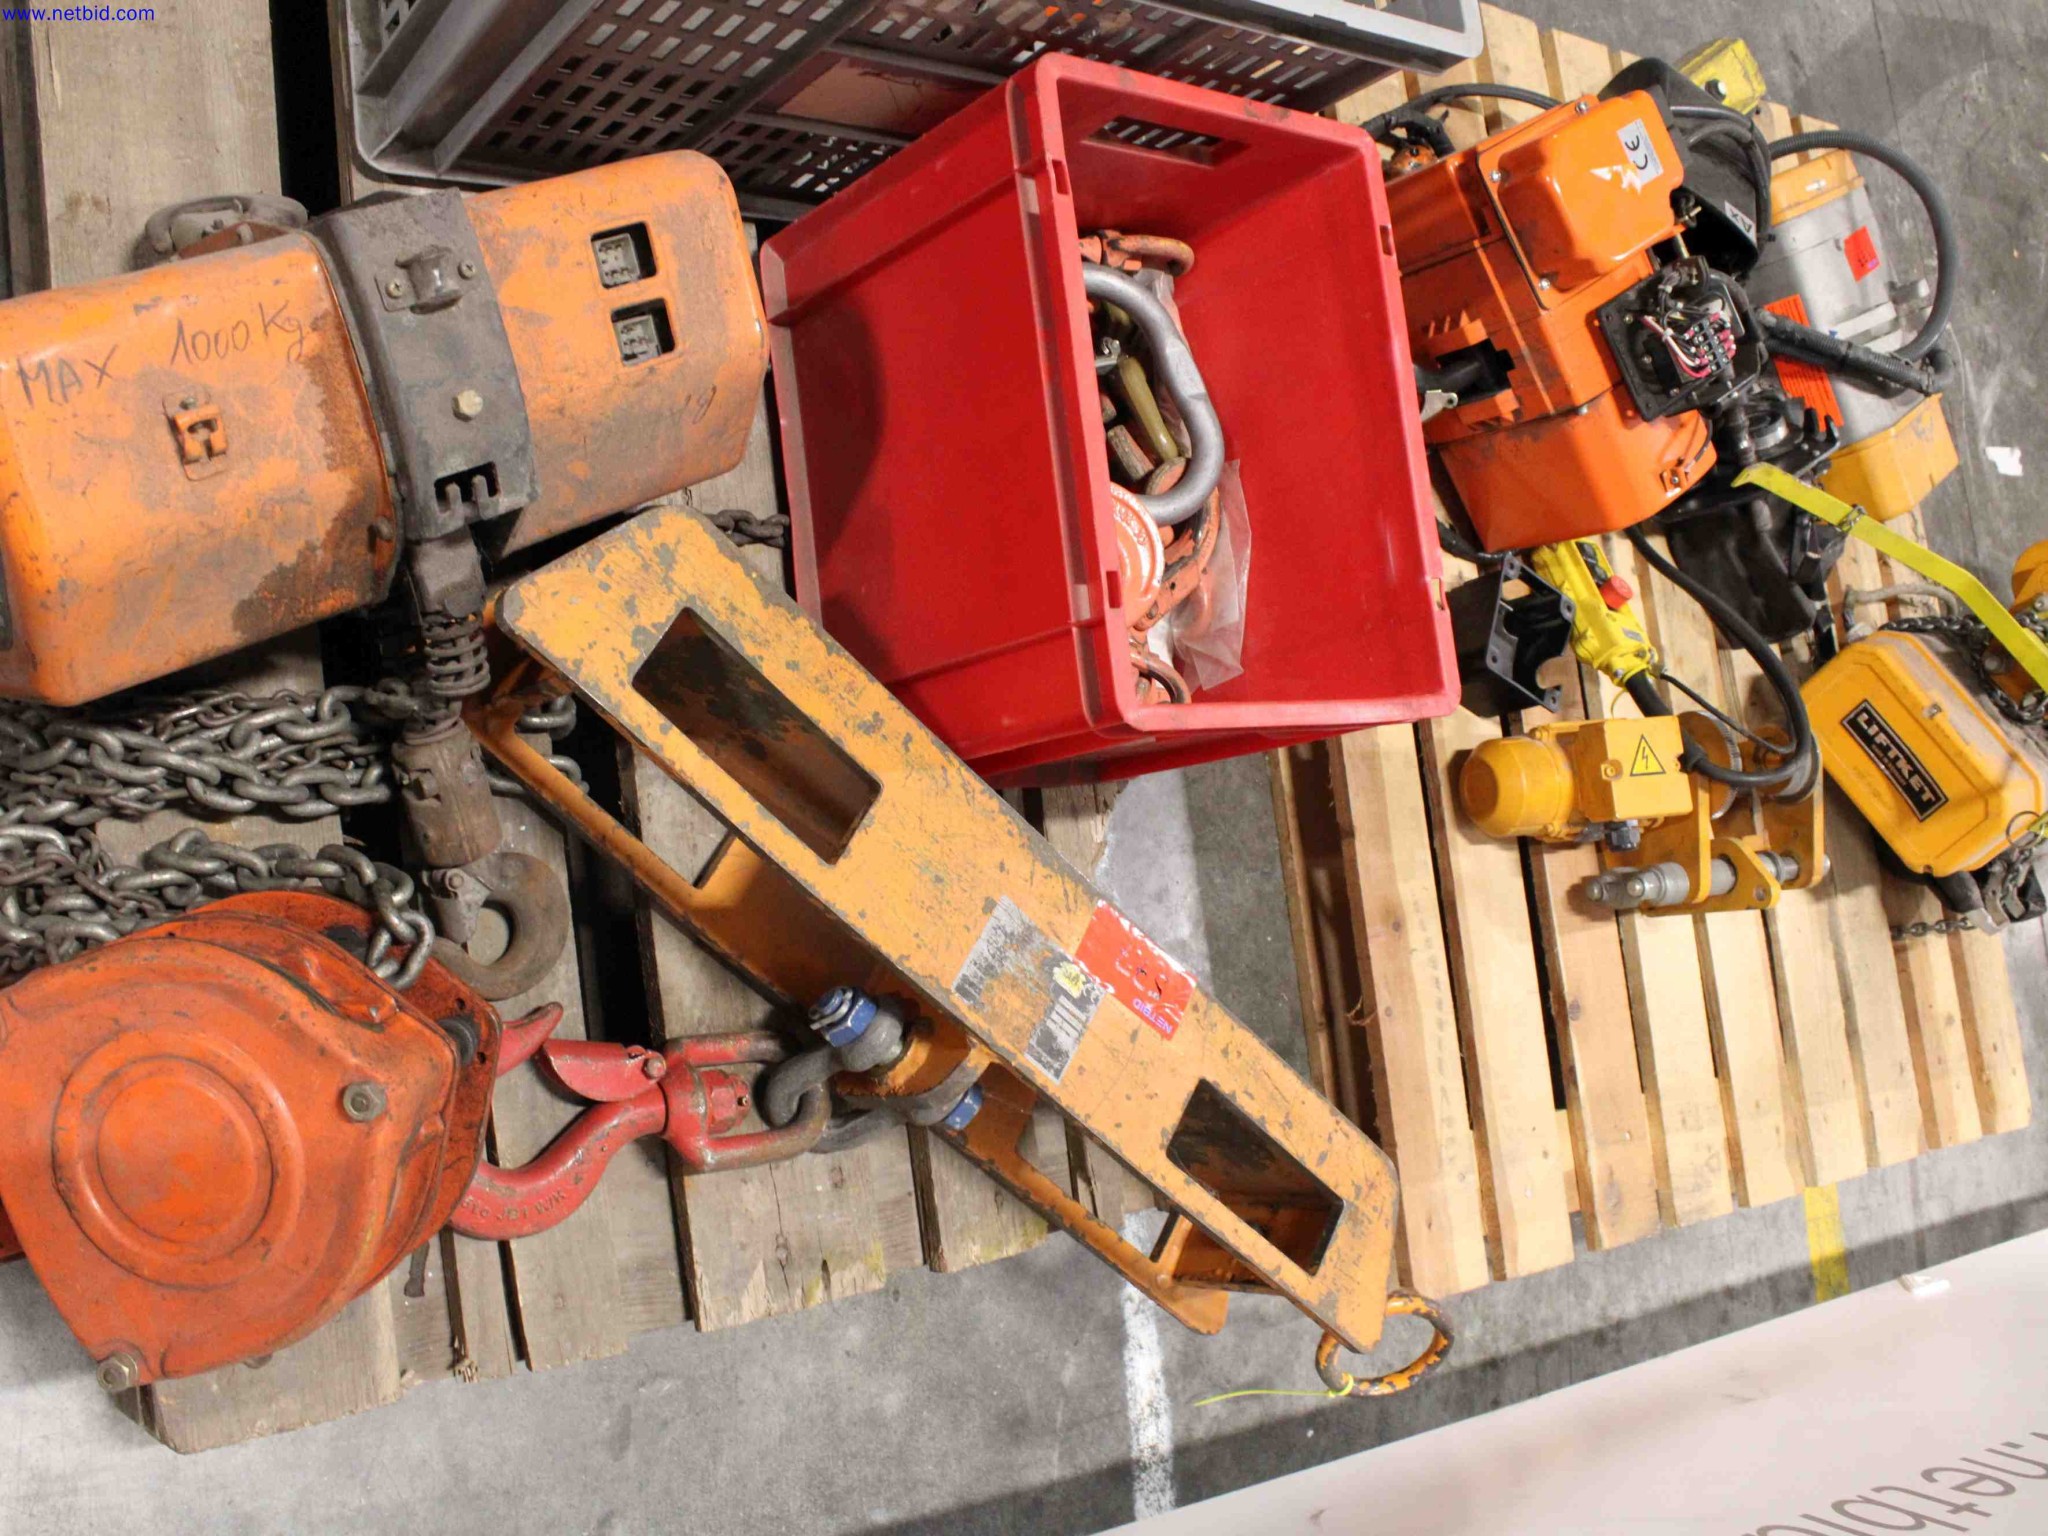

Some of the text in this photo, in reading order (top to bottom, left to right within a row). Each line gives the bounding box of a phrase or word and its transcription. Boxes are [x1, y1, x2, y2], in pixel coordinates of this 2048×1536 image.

[16, 344, 119, 409] MAX
[170, 318, 250, 366] 1000
[1857, 711, 1936, 803] LIFTKET
[1132, 997, 1173, 1035] NETBID
